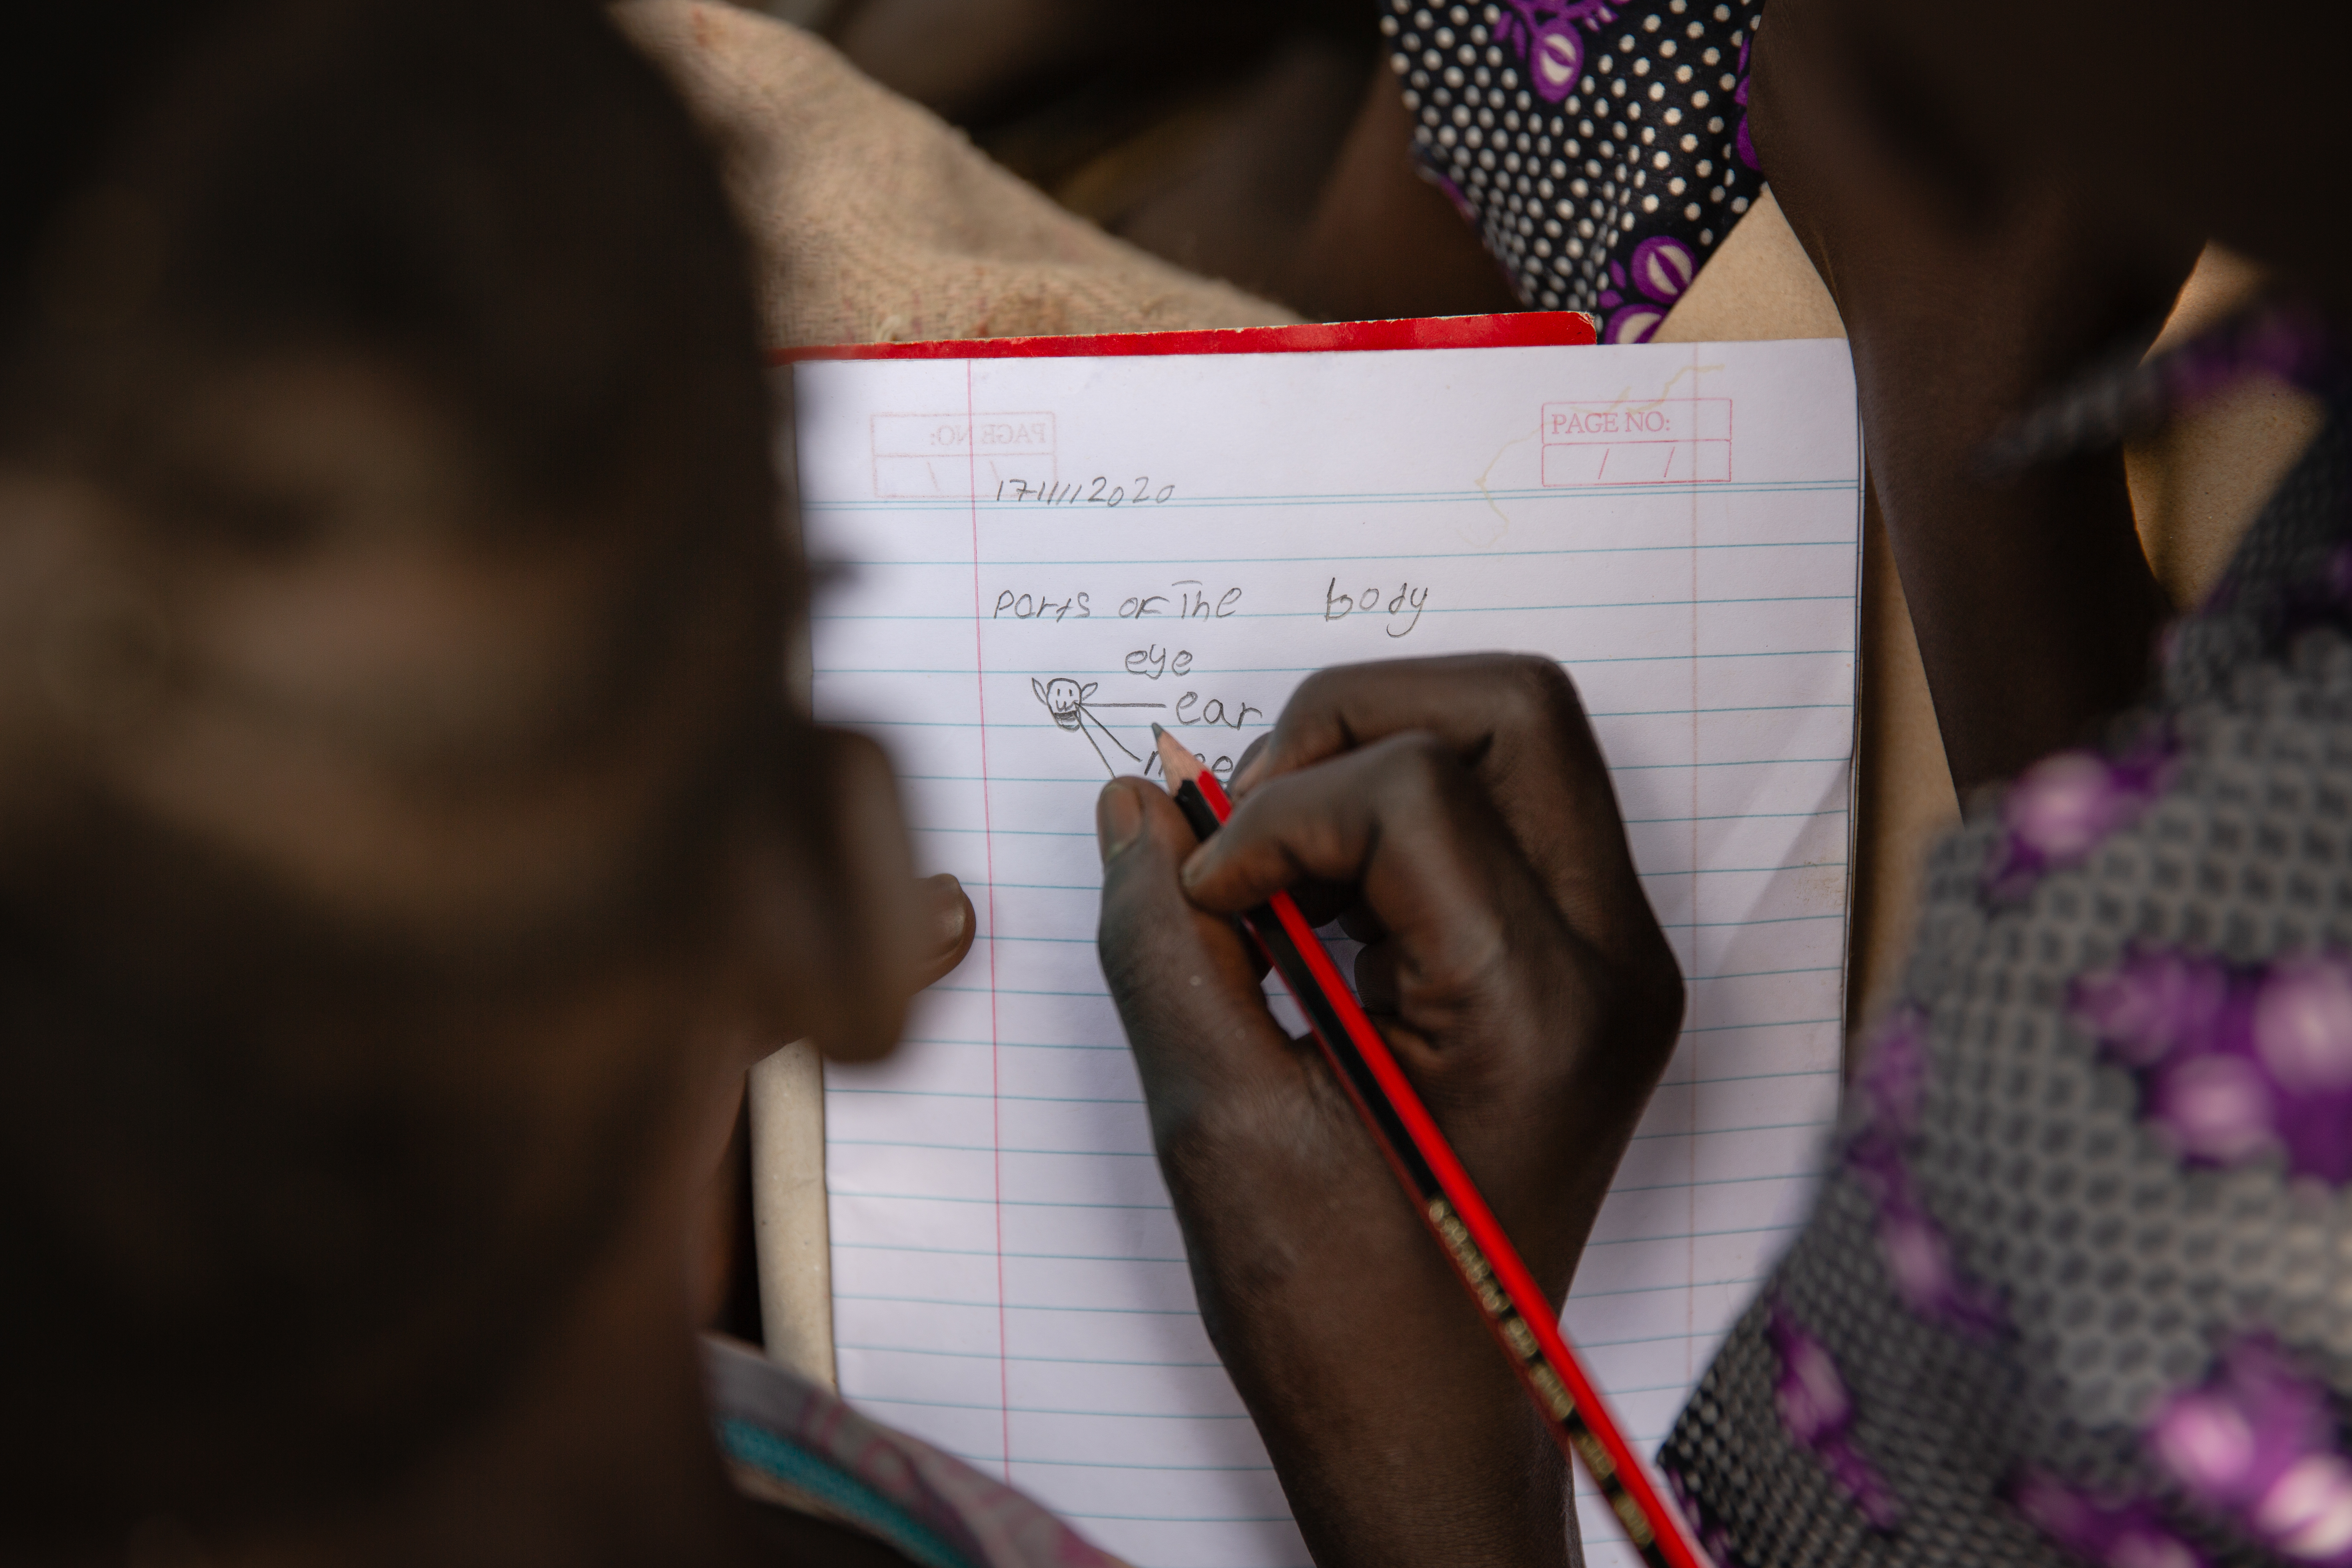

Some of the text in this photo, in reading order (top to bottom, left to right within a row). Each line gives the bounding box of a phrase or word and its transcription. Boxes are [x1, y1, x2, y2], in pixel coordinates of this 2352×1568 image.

[1551, 410, 1671, 434] PAGE NO:
[1324, 577, 1428, 639] body
[1125, 644, 1193, 680] eye
[1176, 691, 1263, 731] ear
